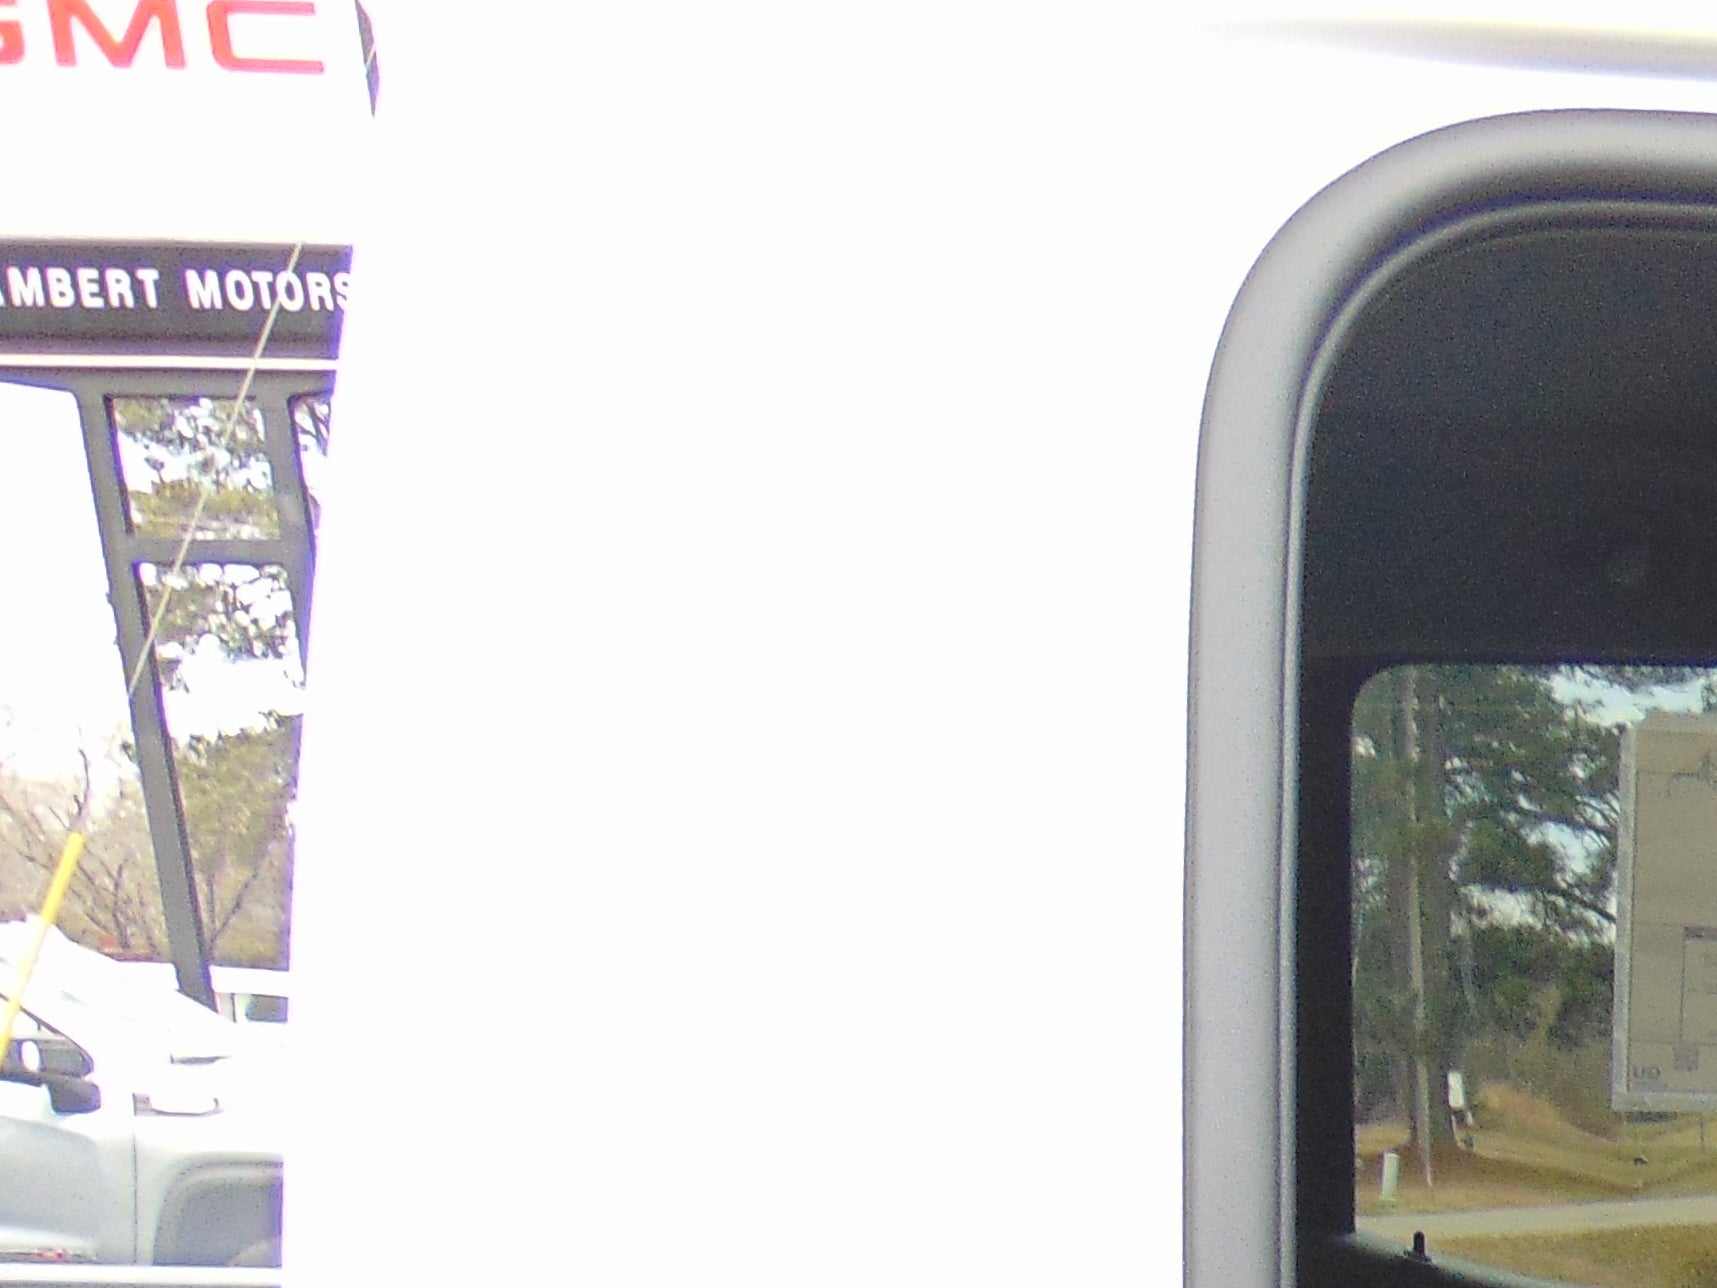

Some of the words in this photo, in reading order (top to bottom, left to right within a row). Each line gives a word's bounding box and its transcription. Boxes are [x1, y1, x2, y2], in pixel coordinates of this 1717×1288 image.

[0, 0, 324, 75] MC
[0, 266, 160, 309] MBERT
[184, 268, 350, 312] MOTORS
